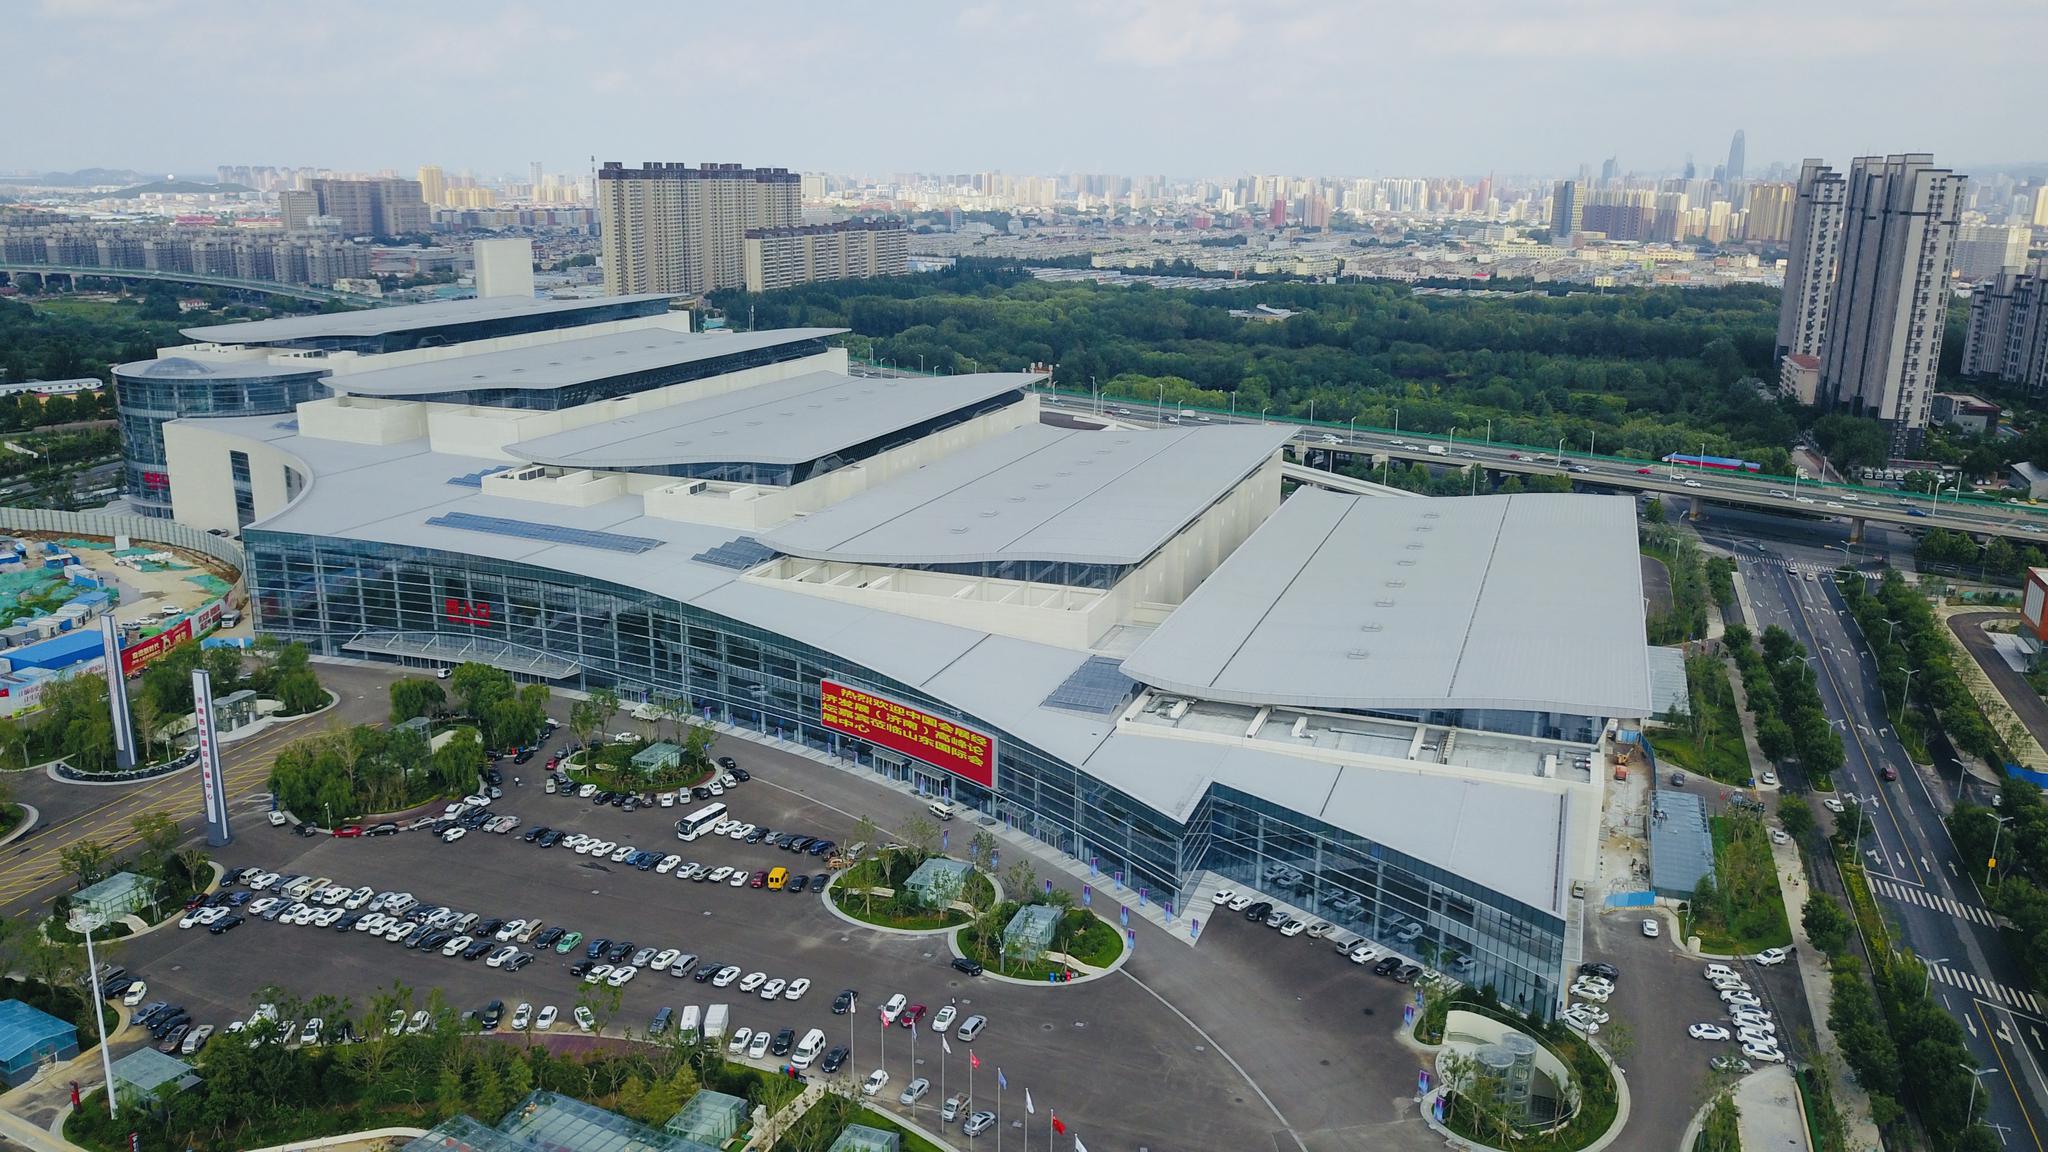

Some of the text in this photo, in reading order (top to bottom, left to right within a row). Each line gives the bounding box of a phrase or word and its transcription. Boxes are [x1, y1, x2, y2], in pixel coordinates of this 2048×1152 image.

[822, 712, 871, 734] 展中心
[822, 703, 984, 767] 坛嘉宾莅临山东国际会
[841, 688, 987, 747] 热烈欢迎中国会展经
